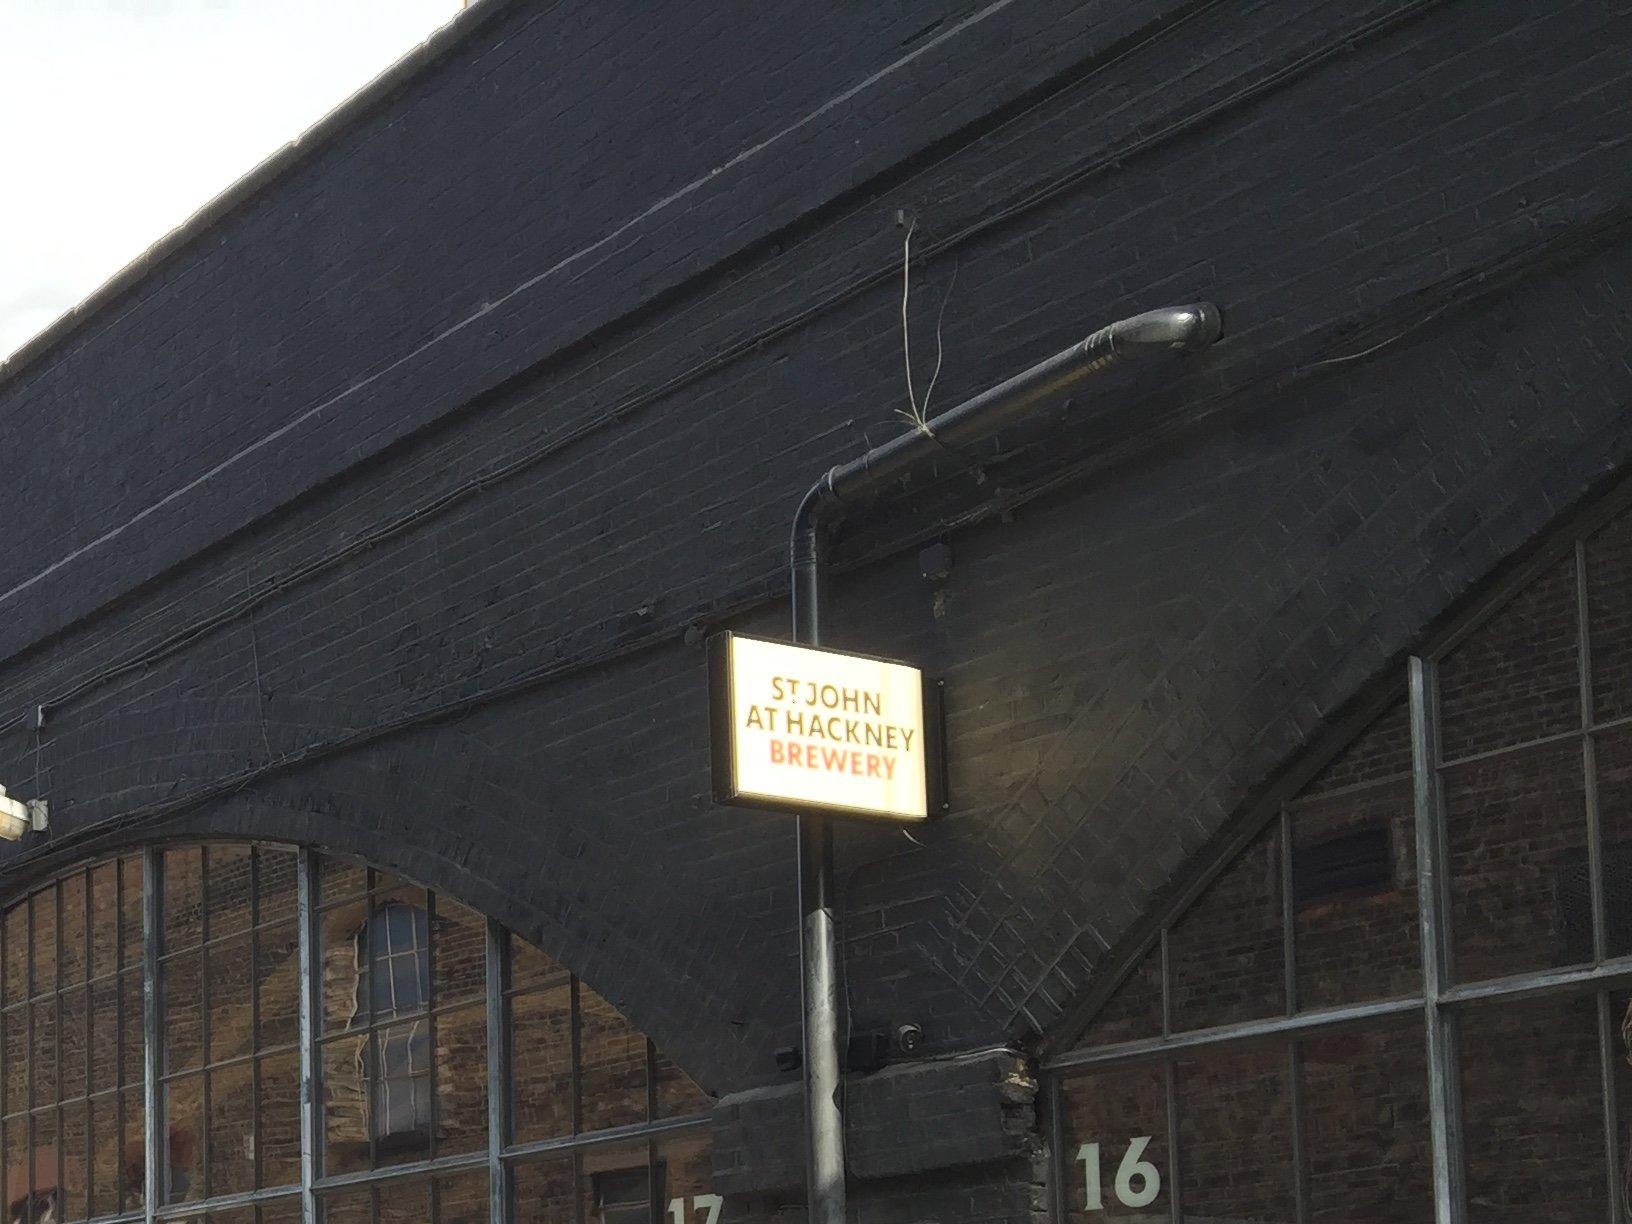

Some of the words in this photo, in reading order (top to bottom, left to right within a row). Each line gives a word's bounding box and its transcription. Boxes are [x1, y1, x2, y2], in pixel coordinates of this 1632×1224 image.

[806, 683, 881, 716] JOHN
[746, 705, 778, 731] AT
[786, 709, 916, 752] HACKNEY
[769, 739, 897, 780] BREWERY
[1075, 1136, 1161, 1211] 16
